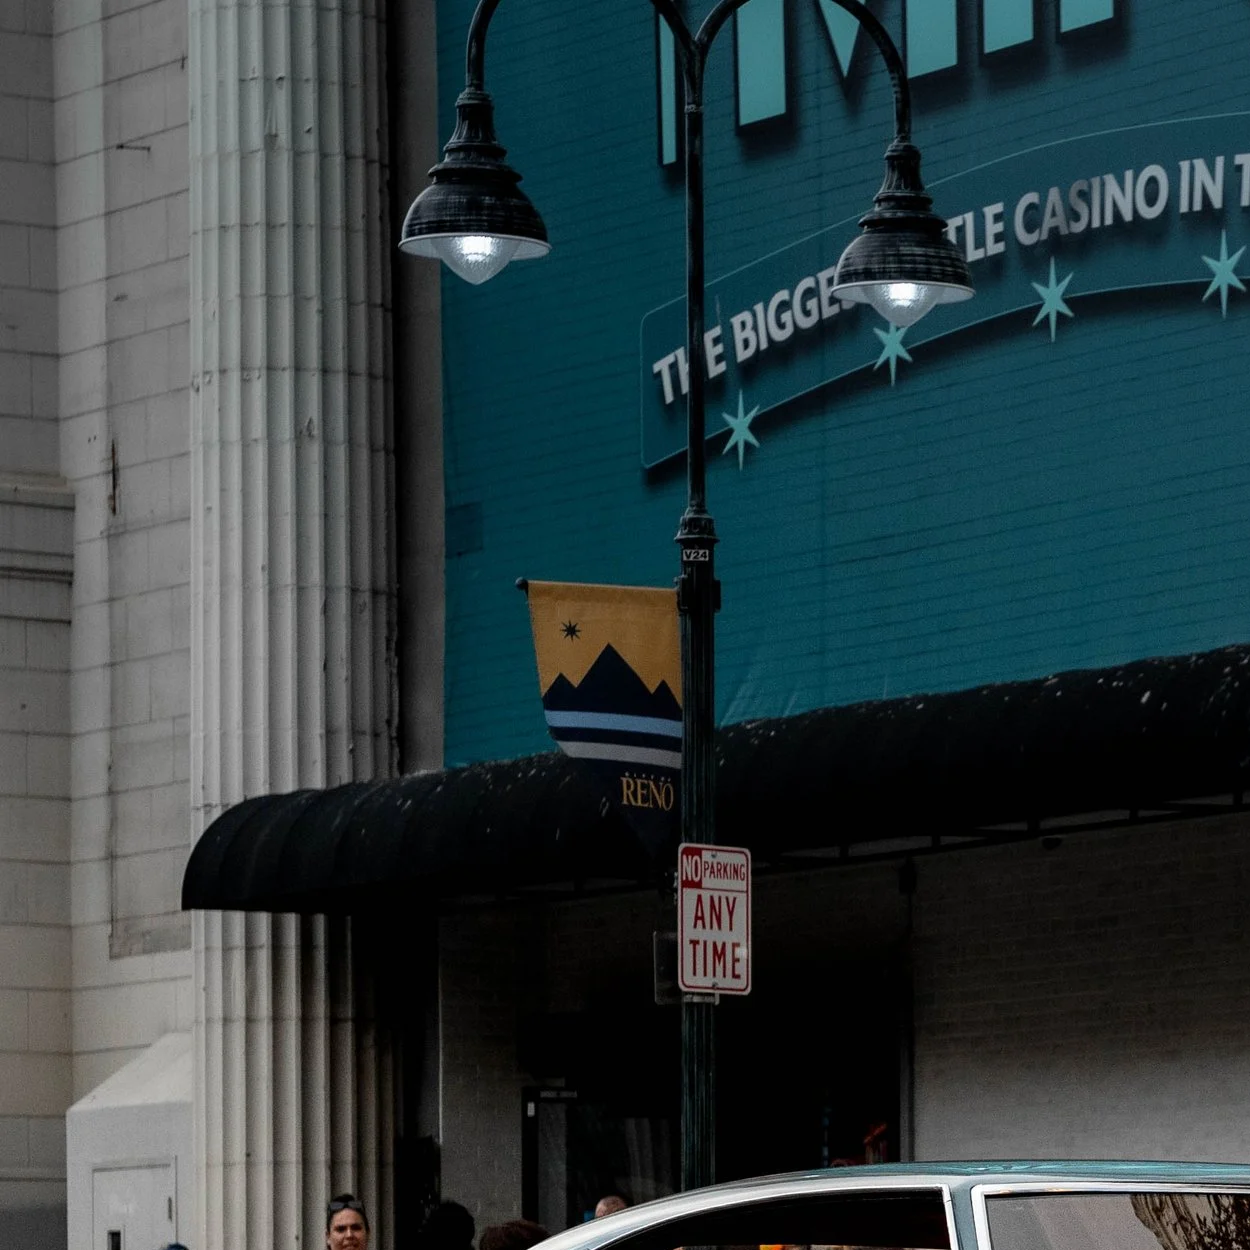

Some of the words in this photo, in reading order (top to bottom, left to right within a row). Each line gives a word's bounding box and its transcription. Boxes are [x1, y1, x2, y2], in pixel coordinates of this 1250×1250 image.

[730, 265, 856, 364] BIGGE
[1013, 164, 1170, 246] CASINO
[1178, 156, 1225, 213] IN
[684, 550, 708, 560] V24
[620, 776, 675, 812] RENO
[683, 855, 701, 881] NO
[703, 860, 746, 882] PARKING
[693, 894, 737, 932] ANY
[689, 939, 742, 980] TIME
